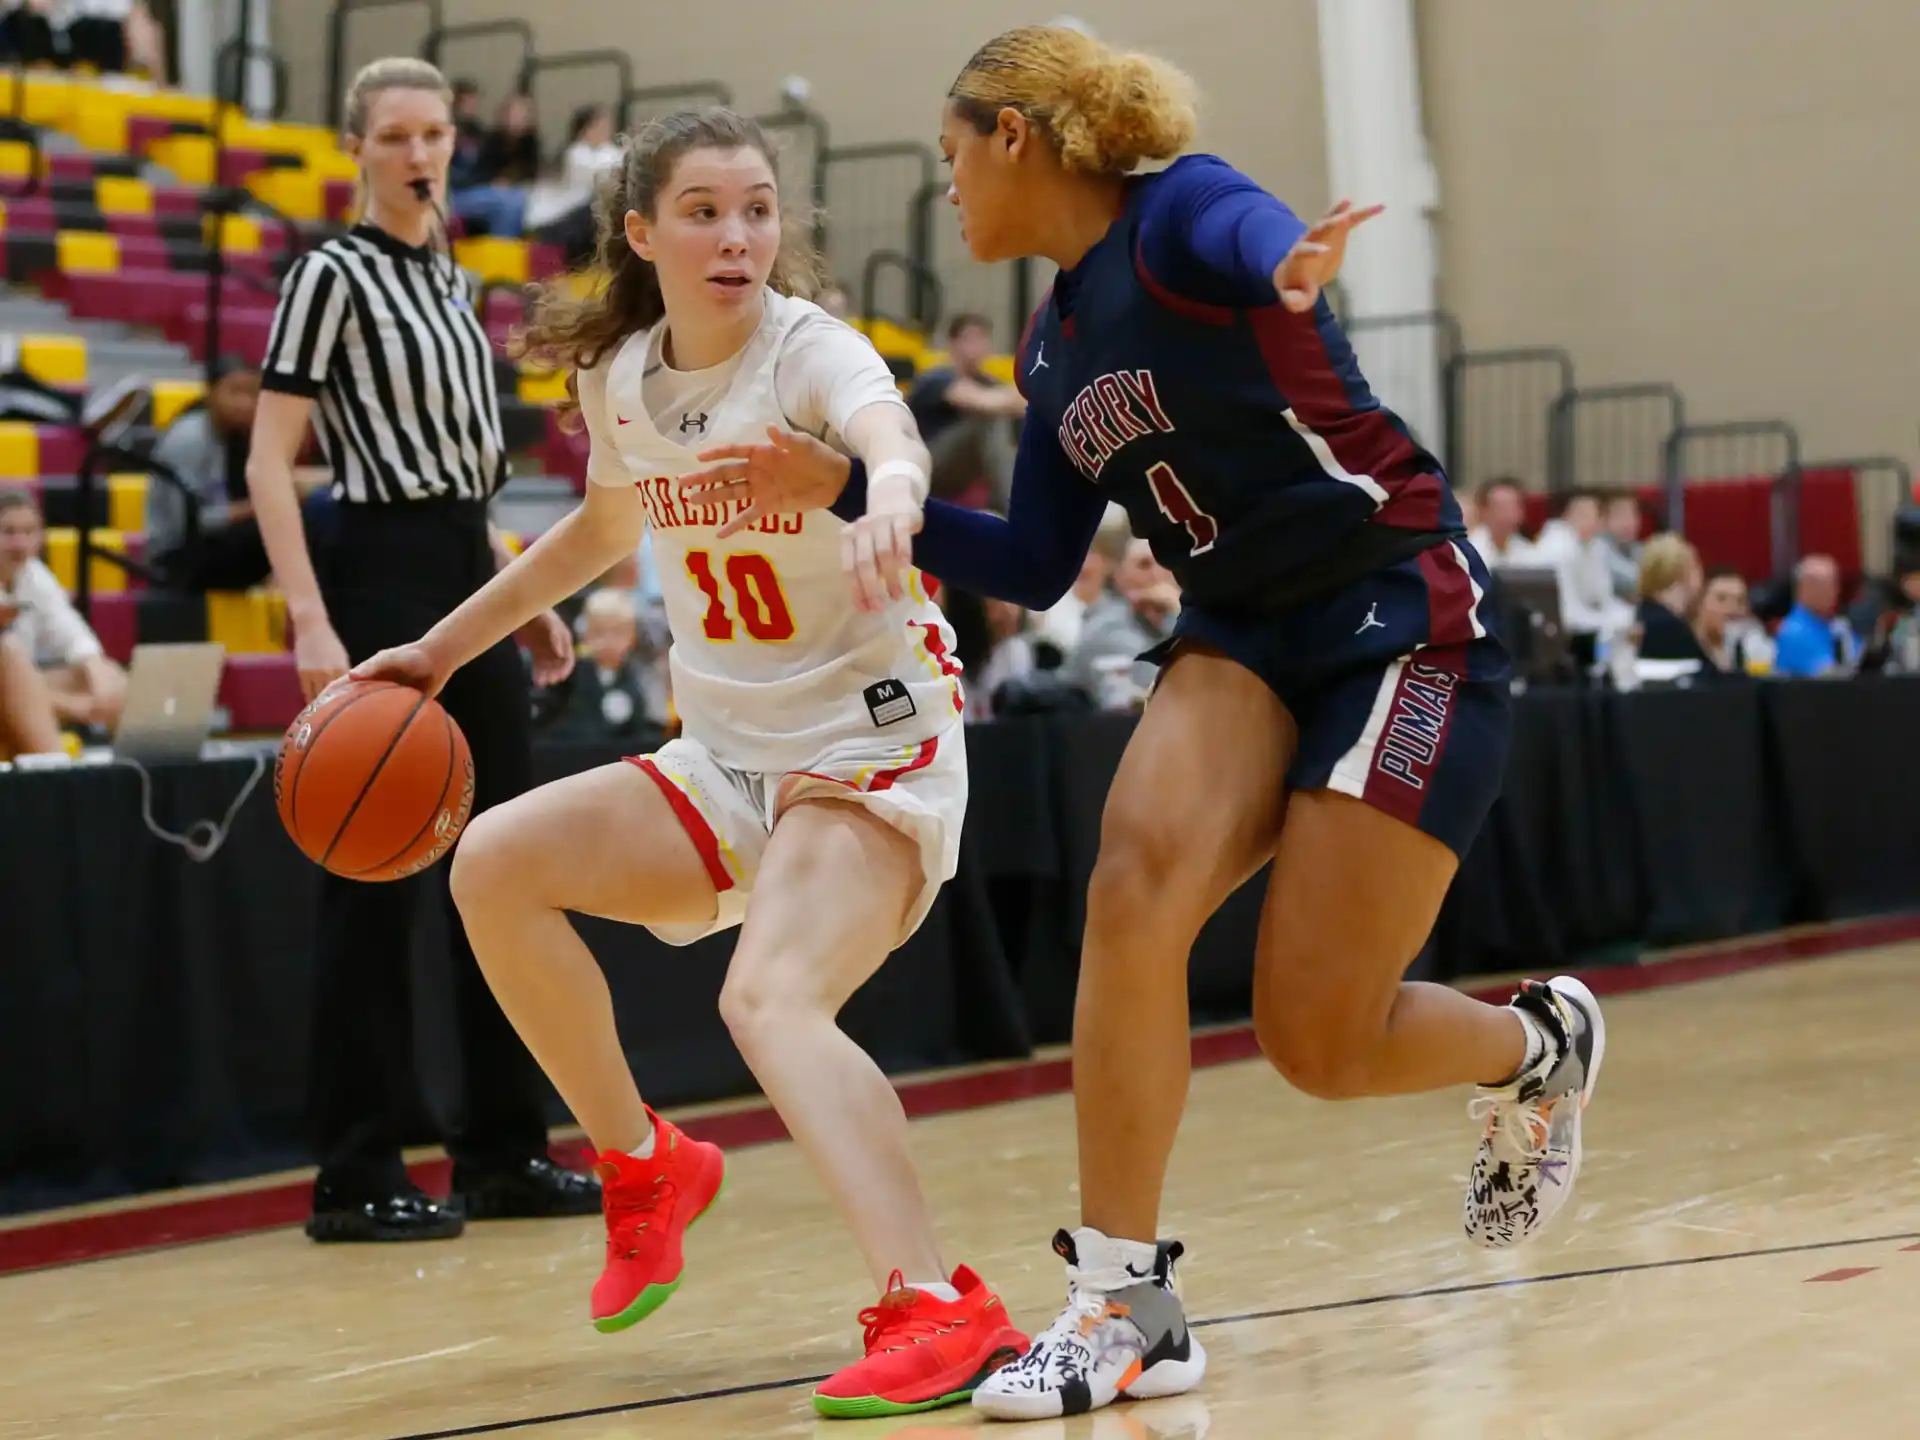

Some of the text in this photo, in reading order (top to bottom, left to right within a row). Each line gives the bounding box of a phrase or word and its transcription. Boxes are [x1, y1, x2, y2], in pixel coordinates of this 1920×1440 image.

[1145, 460, 1218, 557] 1
[684, 547, 798, 642] 10
[876, 684, 894, 700] M
[1377, 662, 1459, 789] PUMAS
